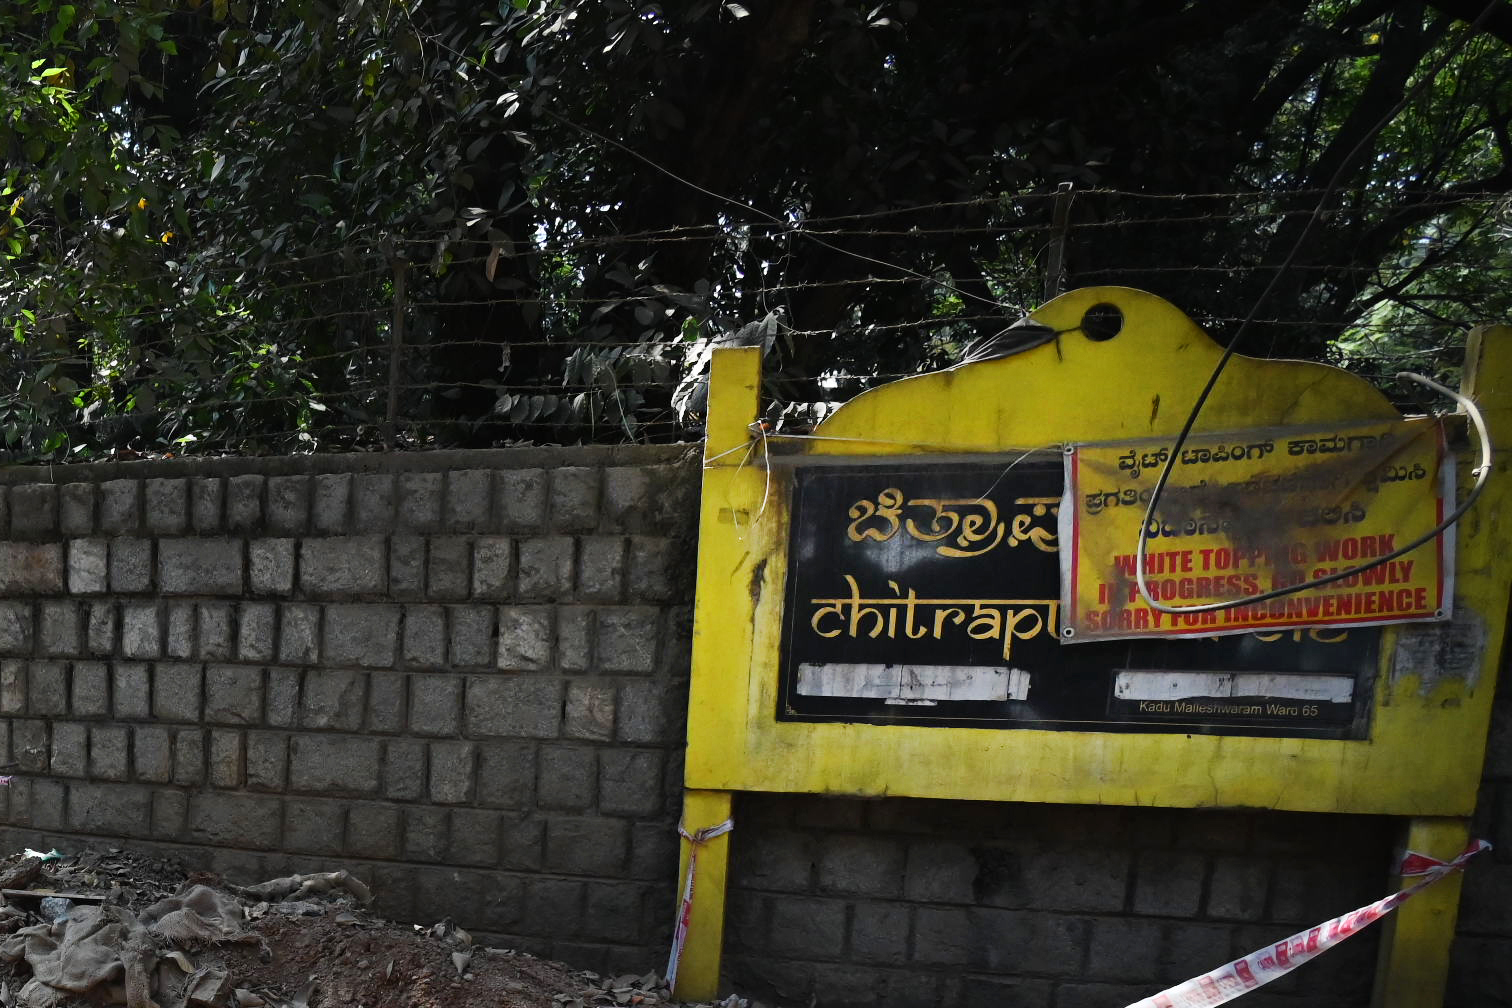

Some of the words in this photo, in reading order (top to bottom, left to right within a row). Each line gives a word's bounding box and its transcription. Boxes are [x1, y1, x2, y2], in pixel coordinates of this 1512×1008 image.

[1119, 447, 1169, 480] ವೈಟ್
[1181, 438, 1274, 466] ಟಾಪಿಂಗ್
[1114, 550, 1193, 577] WHITE
[1317, 535, 1395, 563] WORK
[1086, 607, 1164, 631] SORRY
[1224, 588, 1427, 624] INCONVENIENCE
[1139, 701, 1170, 713] Kadu
[1302, 705, 1318, 716] 65
